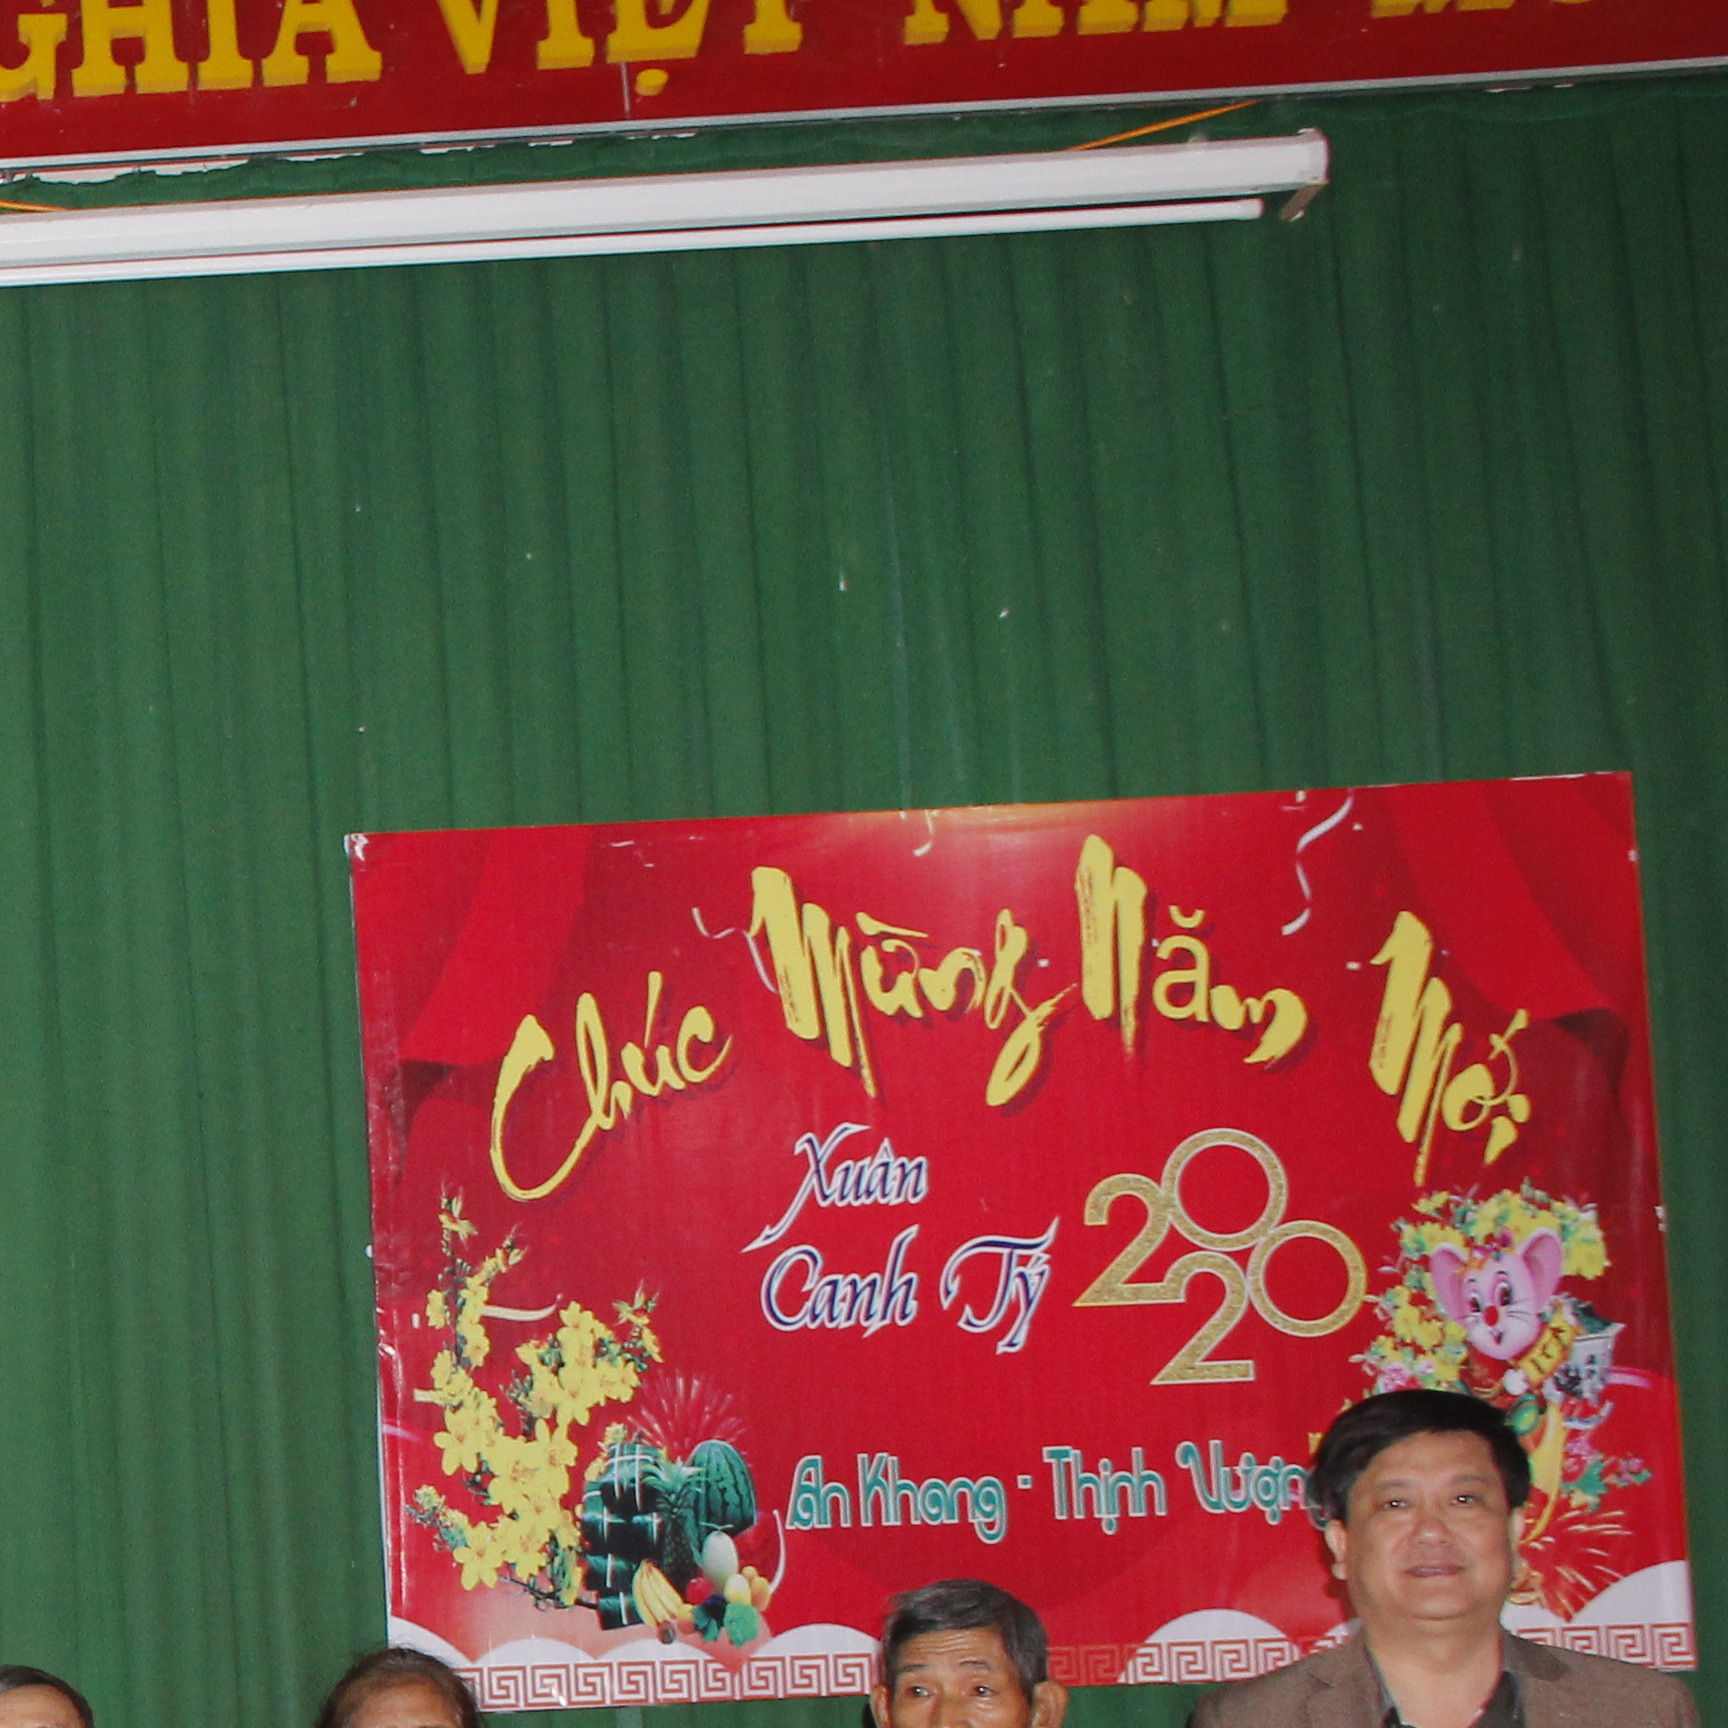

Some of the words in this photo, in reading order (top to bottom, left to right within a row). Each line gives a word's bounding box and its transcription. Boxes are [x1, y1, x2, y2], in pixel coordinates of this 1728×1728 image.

[490, 971, 733, 1202] Chúc
[1075, 834, 1308, 1063] Năm
[742, 1122, 928, 1252] Xuân
[761, 1224, 919, 1338] Canh
[940, 1216, 1060, 1354] Tý
[857, 1452, 1006, 1544] Khang
[1044, 1445, 1166, 1535] Thịnh
[1176, 1440, 1328, 1532] Vượn
